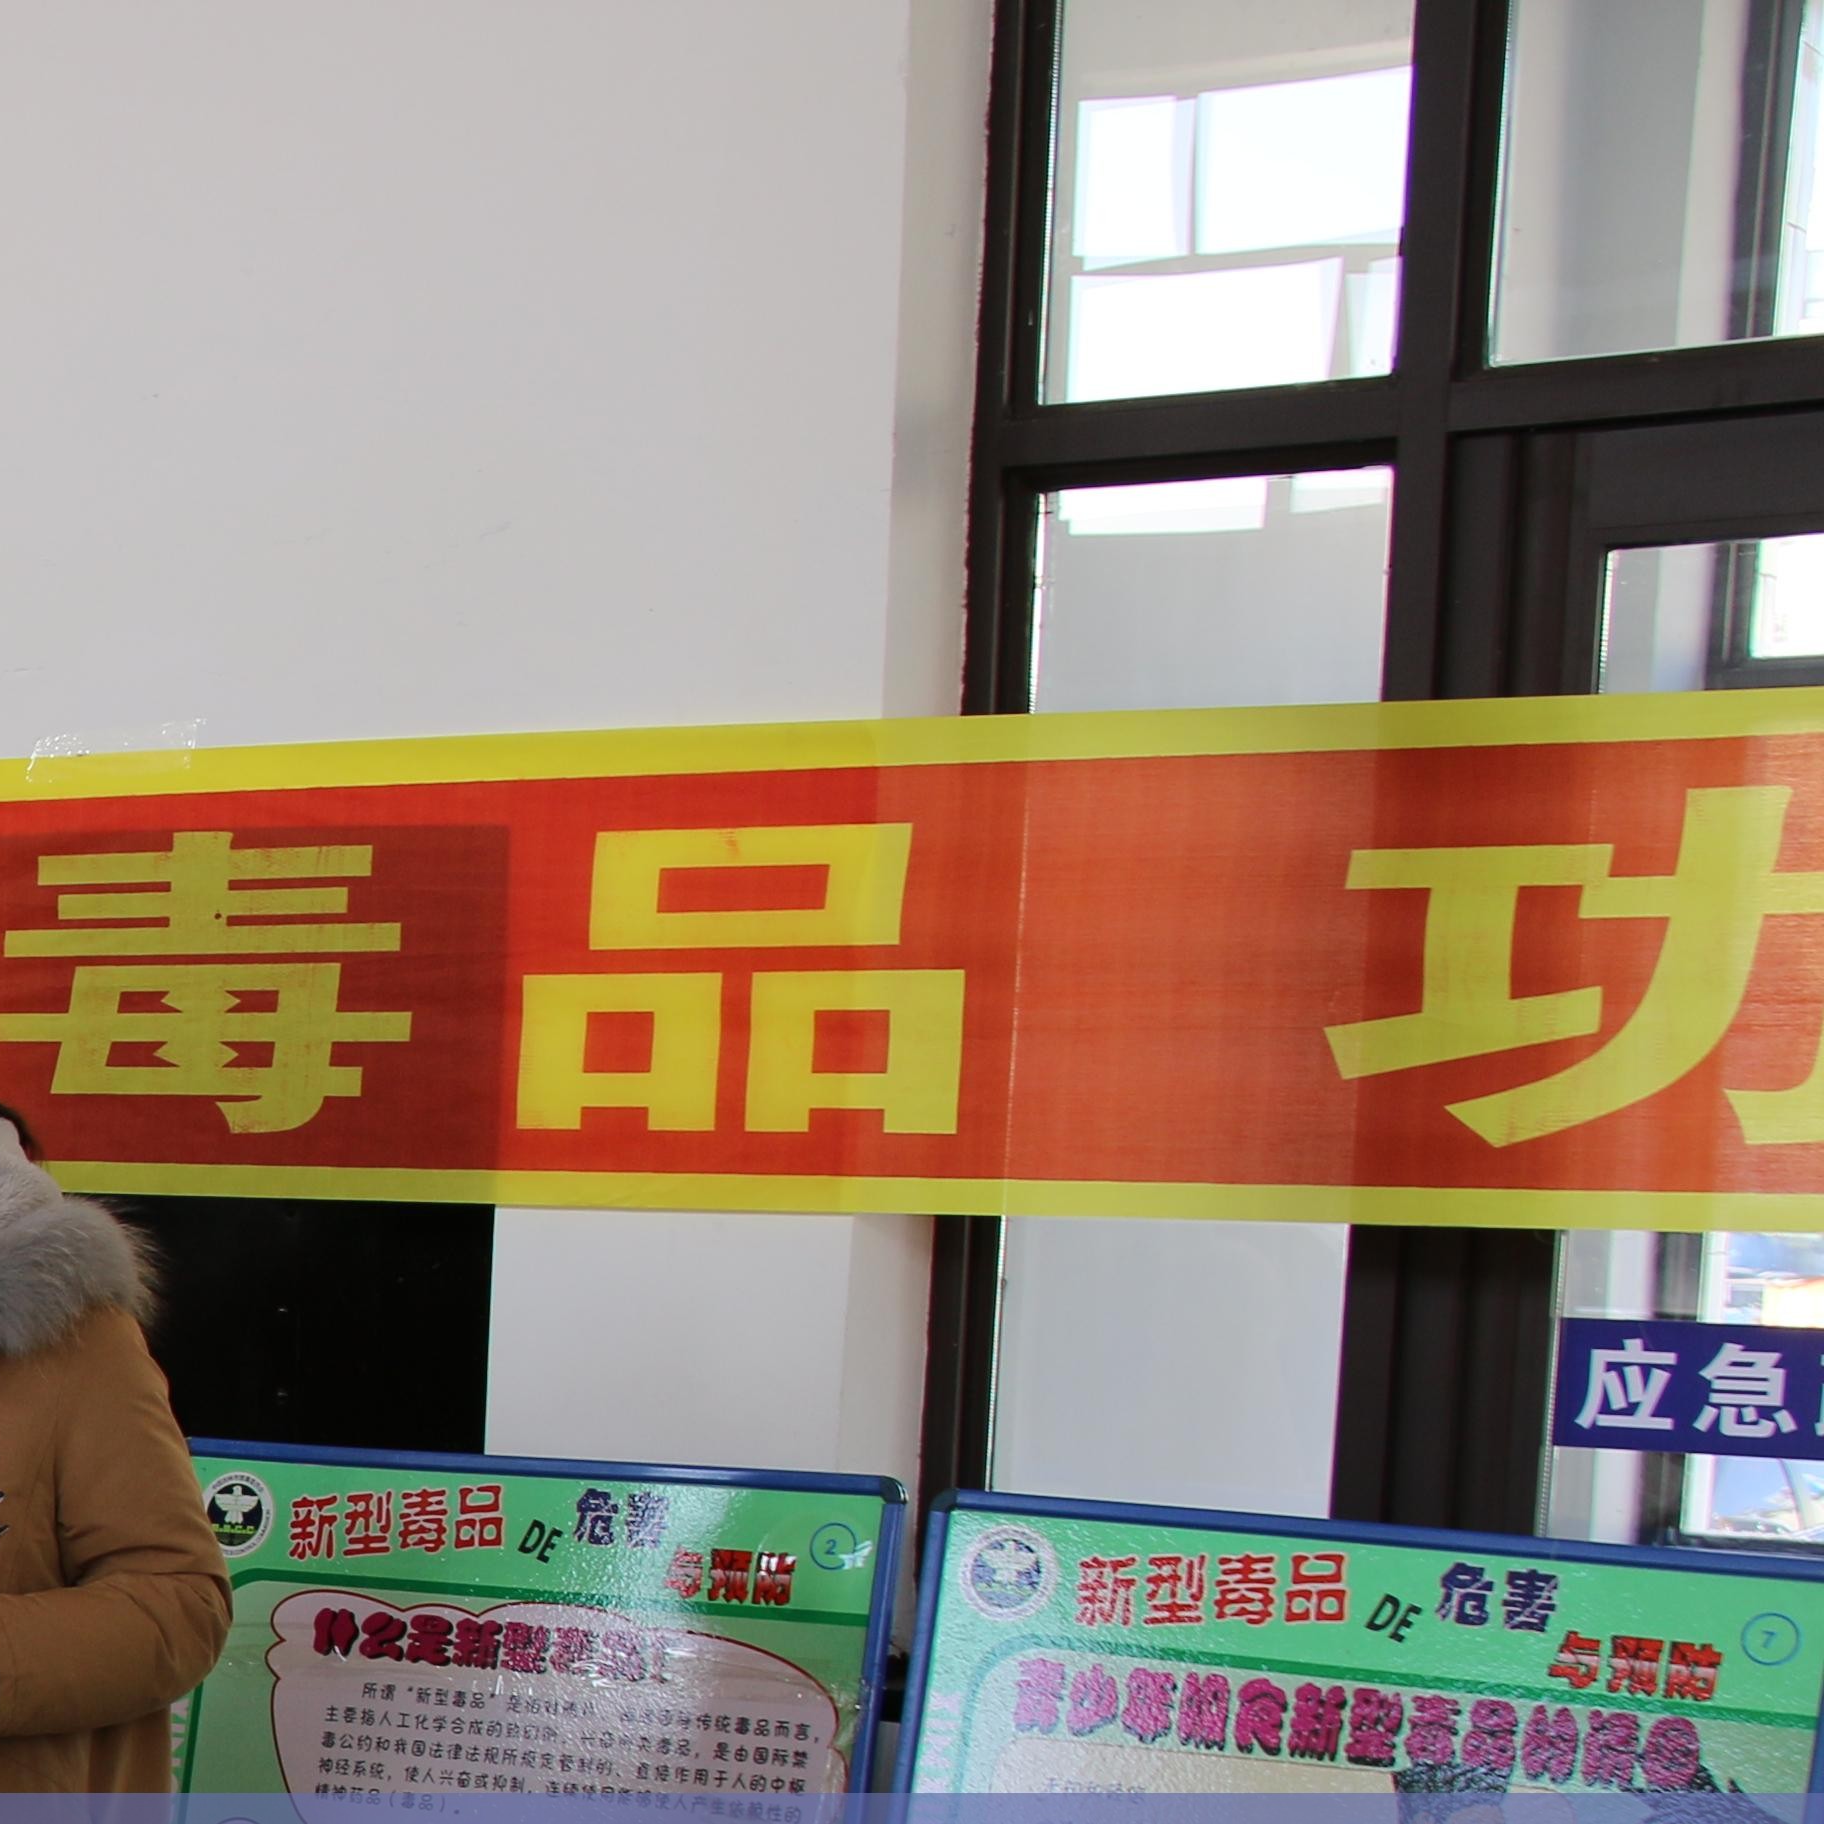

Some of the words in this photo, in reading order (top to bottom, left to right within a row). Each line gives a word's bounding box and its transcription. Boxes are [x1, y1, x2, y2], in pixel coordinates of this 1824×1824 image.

[1324, 786, 1824, 1147] 功
[1574, 1338, 1824, 1438] 应急
[288, 1484, 505, 1560] 新型毒品
[517, 1519, 564, 1564] DE
[824, 1539, 837, 1555] 2
[1076, 1551, 1348, 1628] 新型毒品
[1365, 1594, 1424, 1644] DE
[1436, 1562, 1559, 1632] 危害
[1548, 1631, 1725, 1702] 与预防
